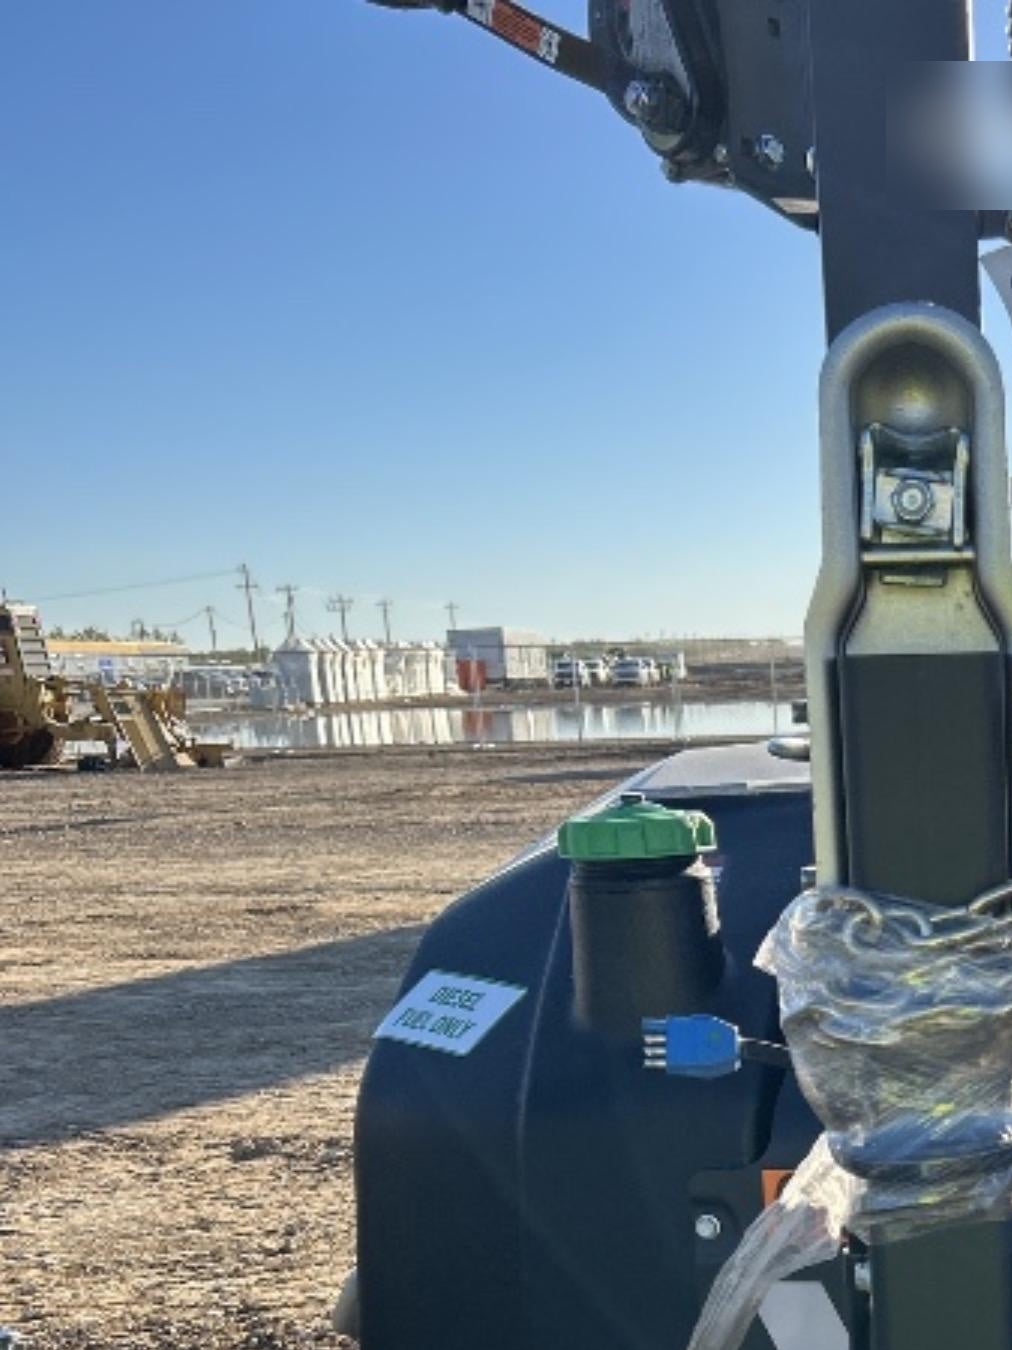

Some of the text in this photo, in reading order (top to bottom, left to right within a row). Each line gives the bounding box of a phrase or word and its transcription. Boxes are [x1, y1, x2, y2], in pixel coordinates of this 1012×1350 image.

[428, 985, 486, 1012] DIESEL
[393, 1007, 477, 1039] FUEL ONLY
